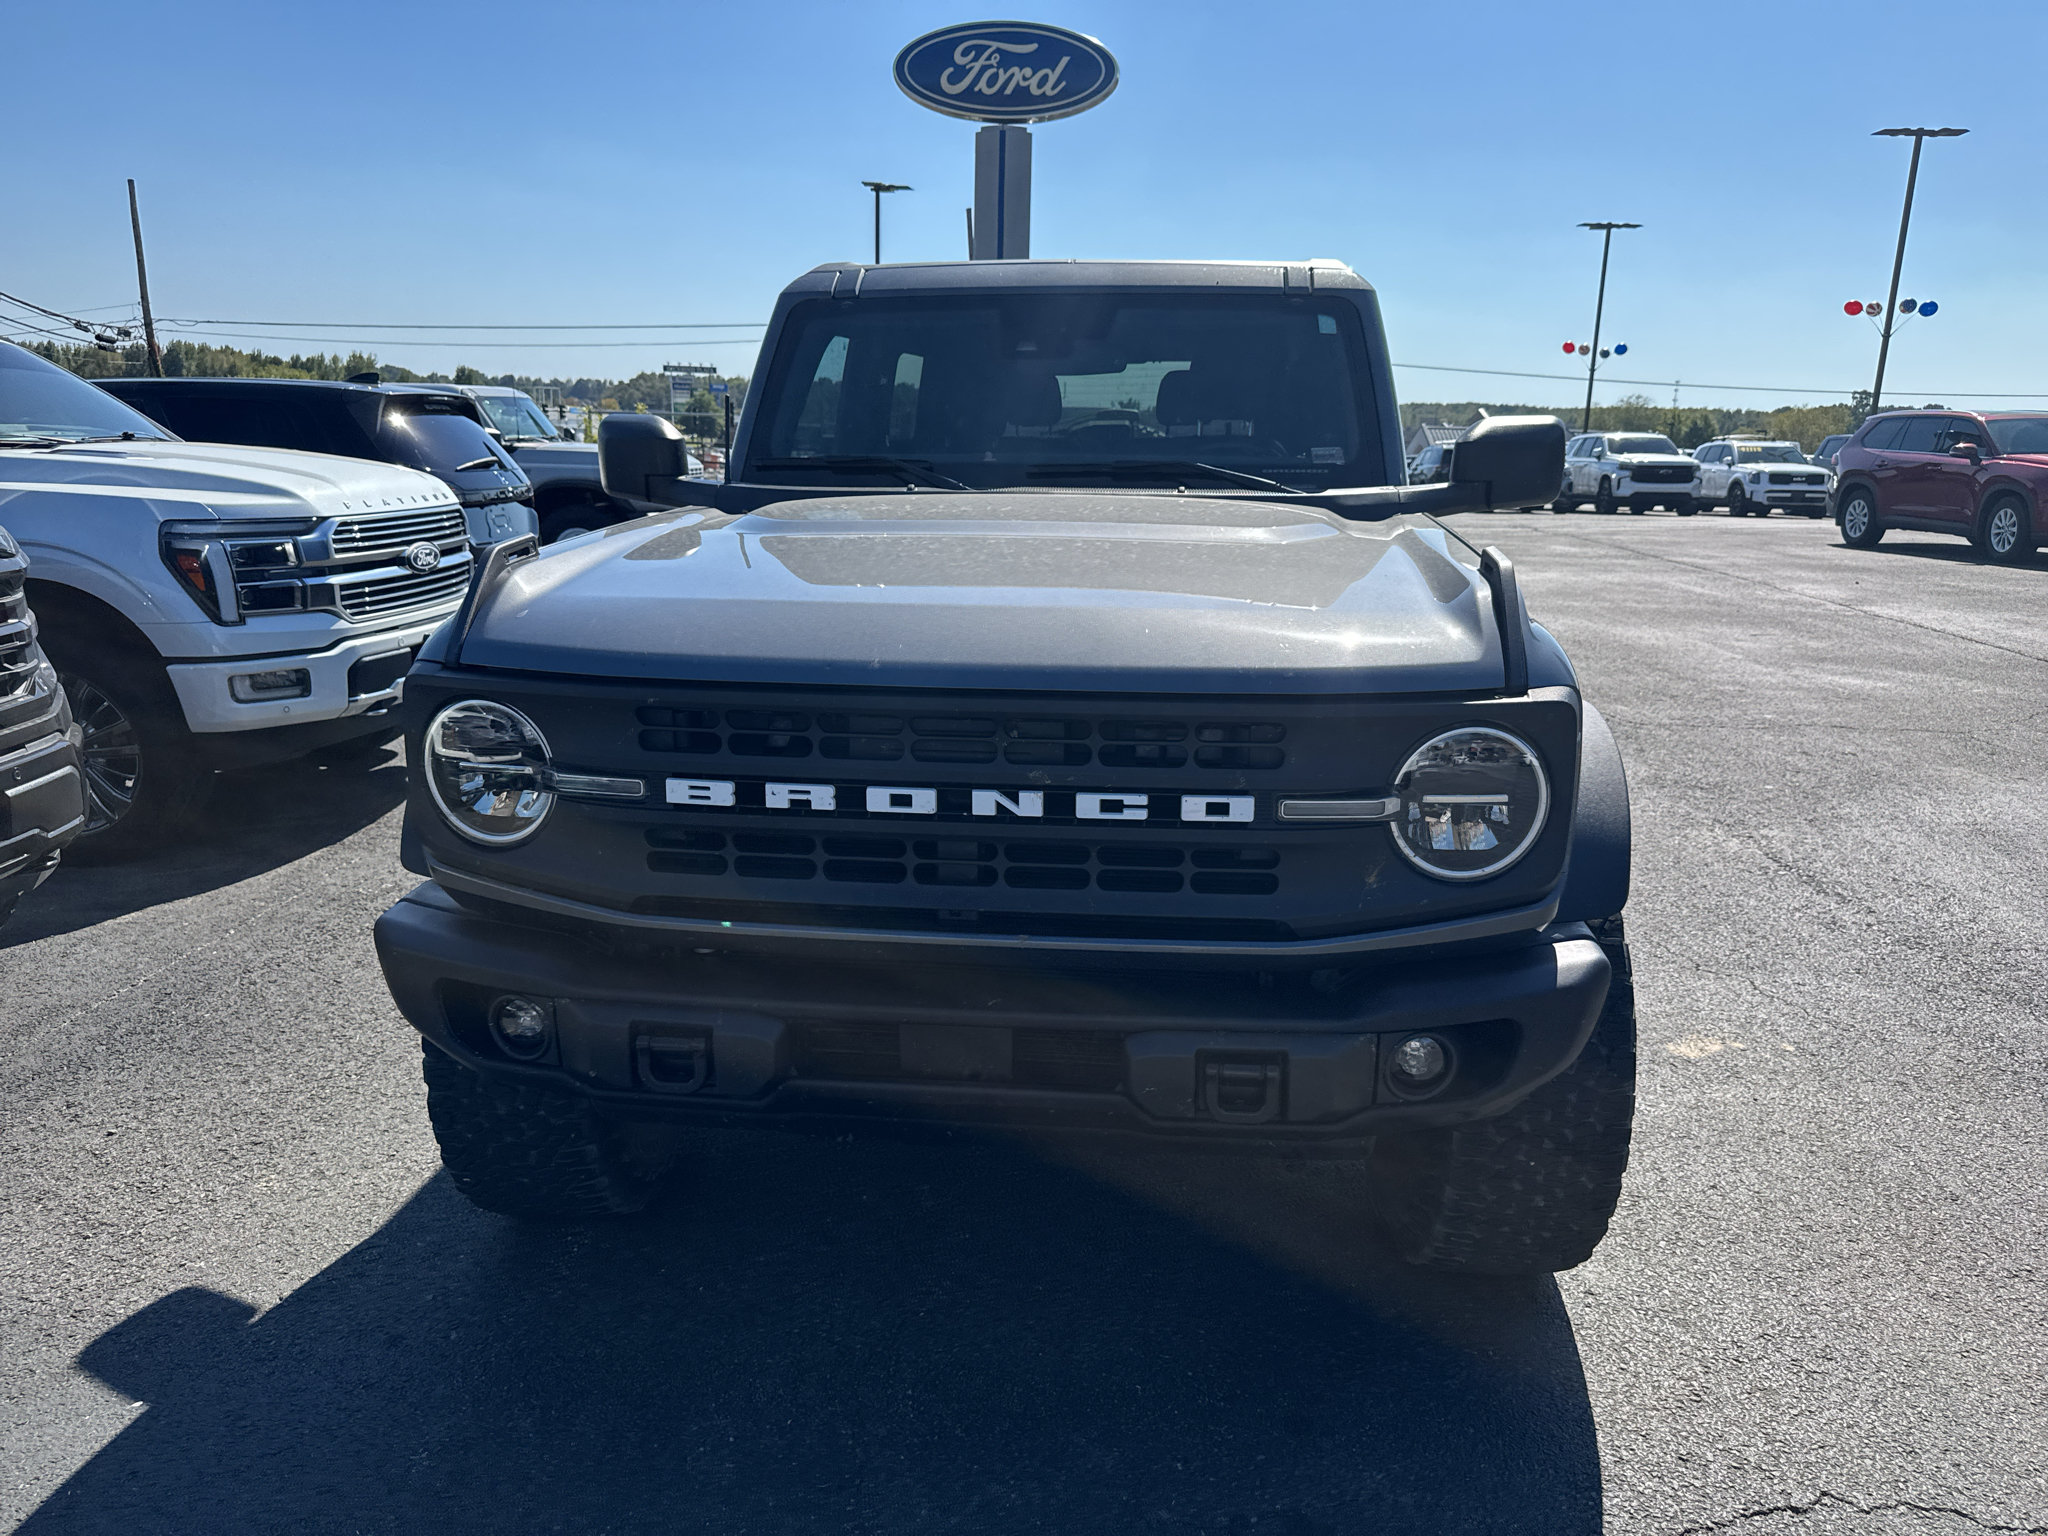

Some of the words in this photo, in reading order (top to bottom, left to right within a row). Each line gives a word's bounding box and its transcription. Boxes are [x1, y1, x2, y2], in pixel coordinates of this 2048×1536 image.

[939, 39, 1071, 96] Ford
[417, 549, 435, 566] Ford
[665, 777, 1256, 823] BRONCO
